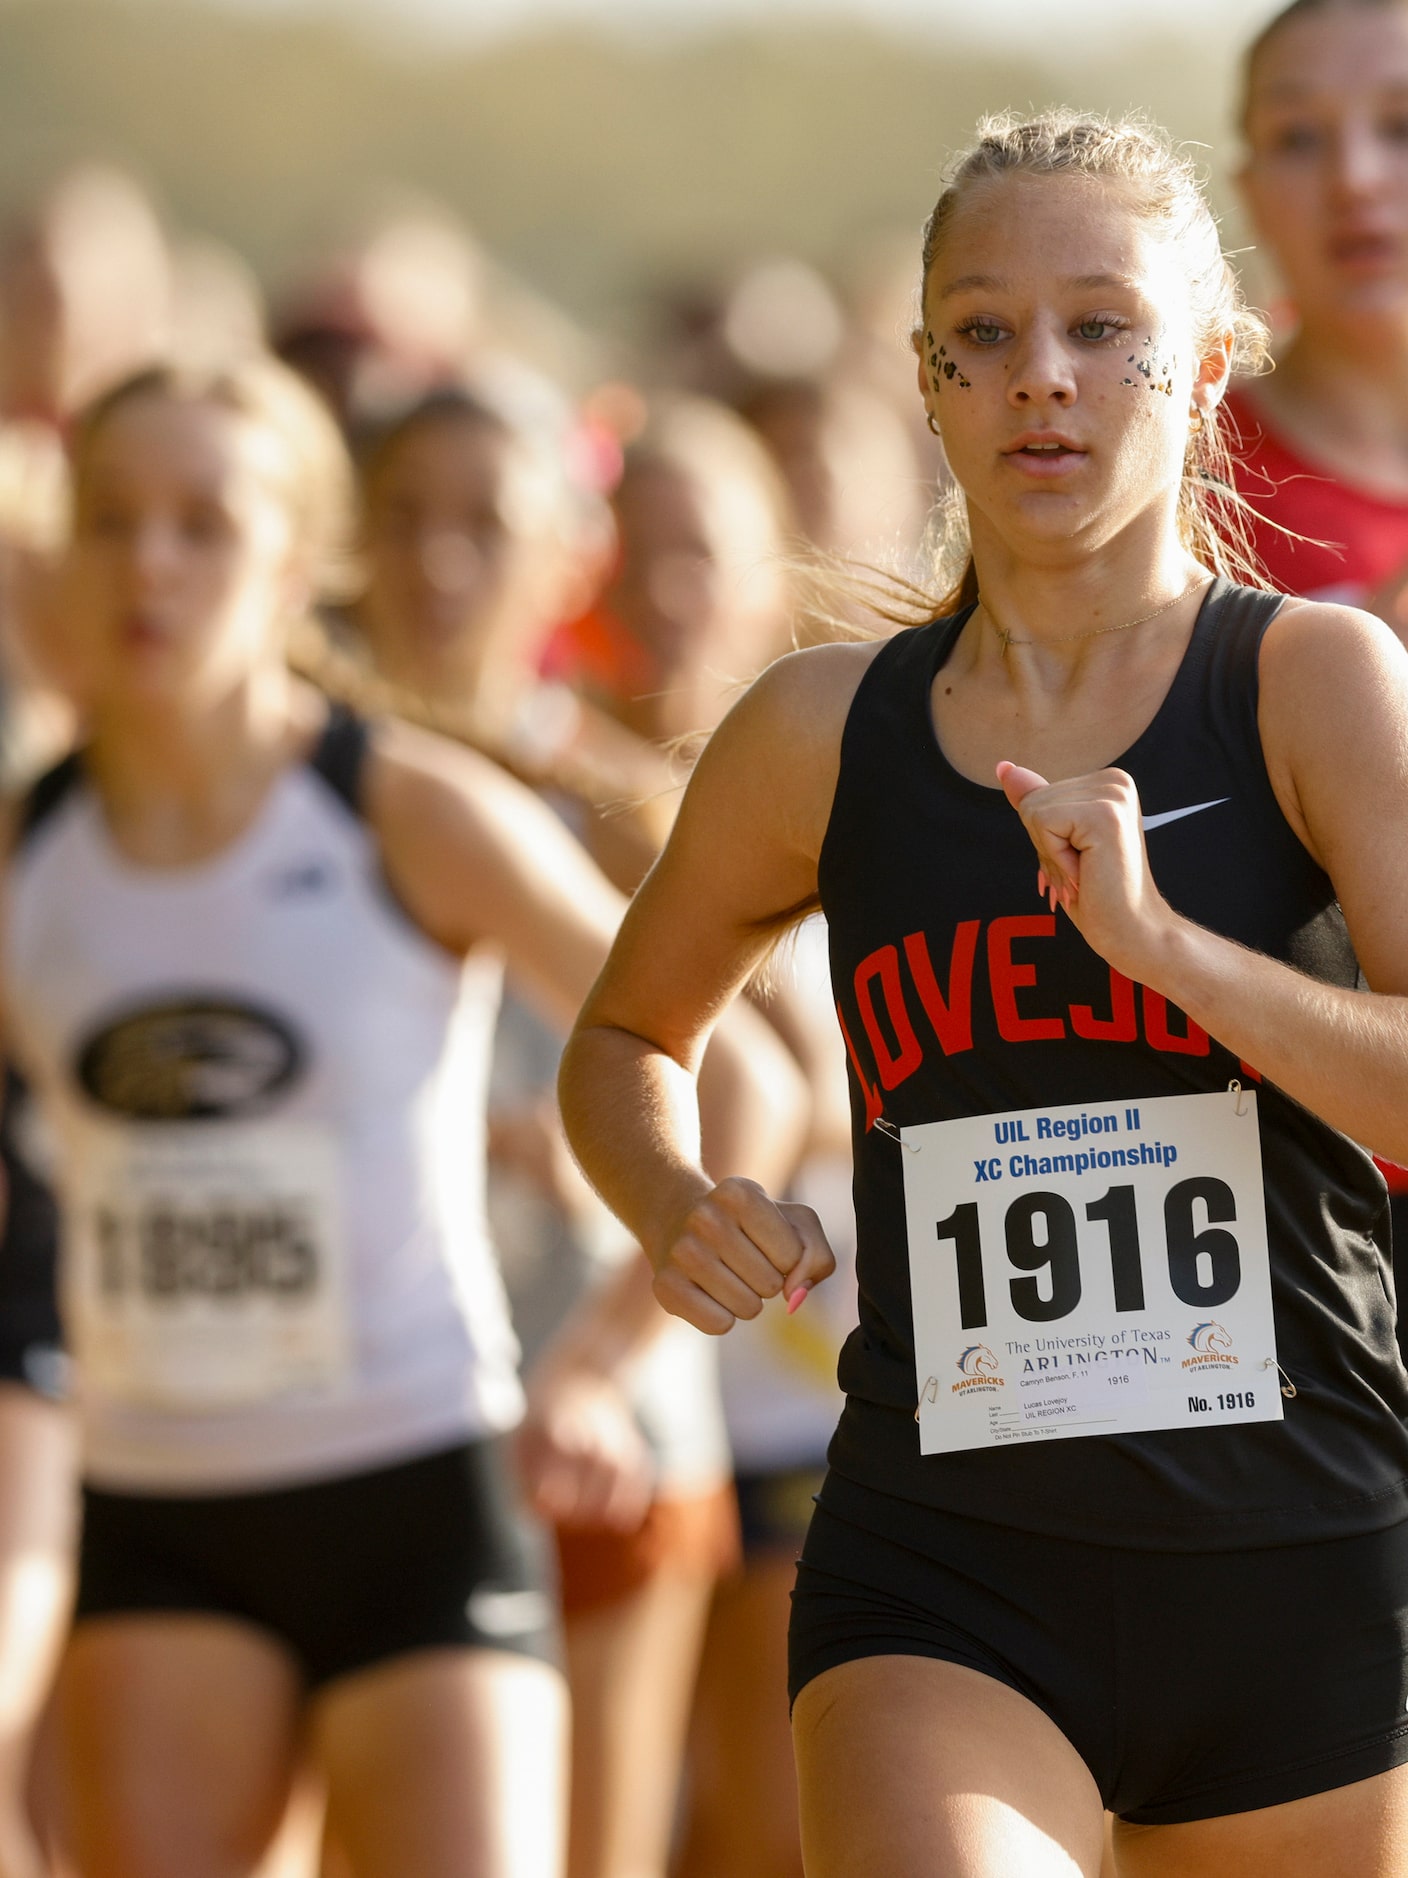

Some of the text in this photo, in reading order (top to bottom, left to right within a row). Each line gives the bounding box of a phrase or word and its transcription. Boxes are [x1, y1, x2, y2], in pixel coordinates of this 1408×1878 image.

[994, 1108, 1141, 1144] UIL Region II
[974, 1141, 1178, 1182] XC Championship
[936, 1176, 1241, 1330] 1916
[1005, 1329, 1171, 1355] The University of Texas
[1181, 1353, 1239, 1369] MAVERICKS
[952, 1376, 1005, 1393] MAVERICKS
[1107, 1375, 1130, 1386] 1916
[1023, 1397, 1068, 1410] Lucas Lovejoy
[1188, 1391, 1255, 1413] No. 1916
[1025, 1405, 1077, 1420] UIL REGION XC
